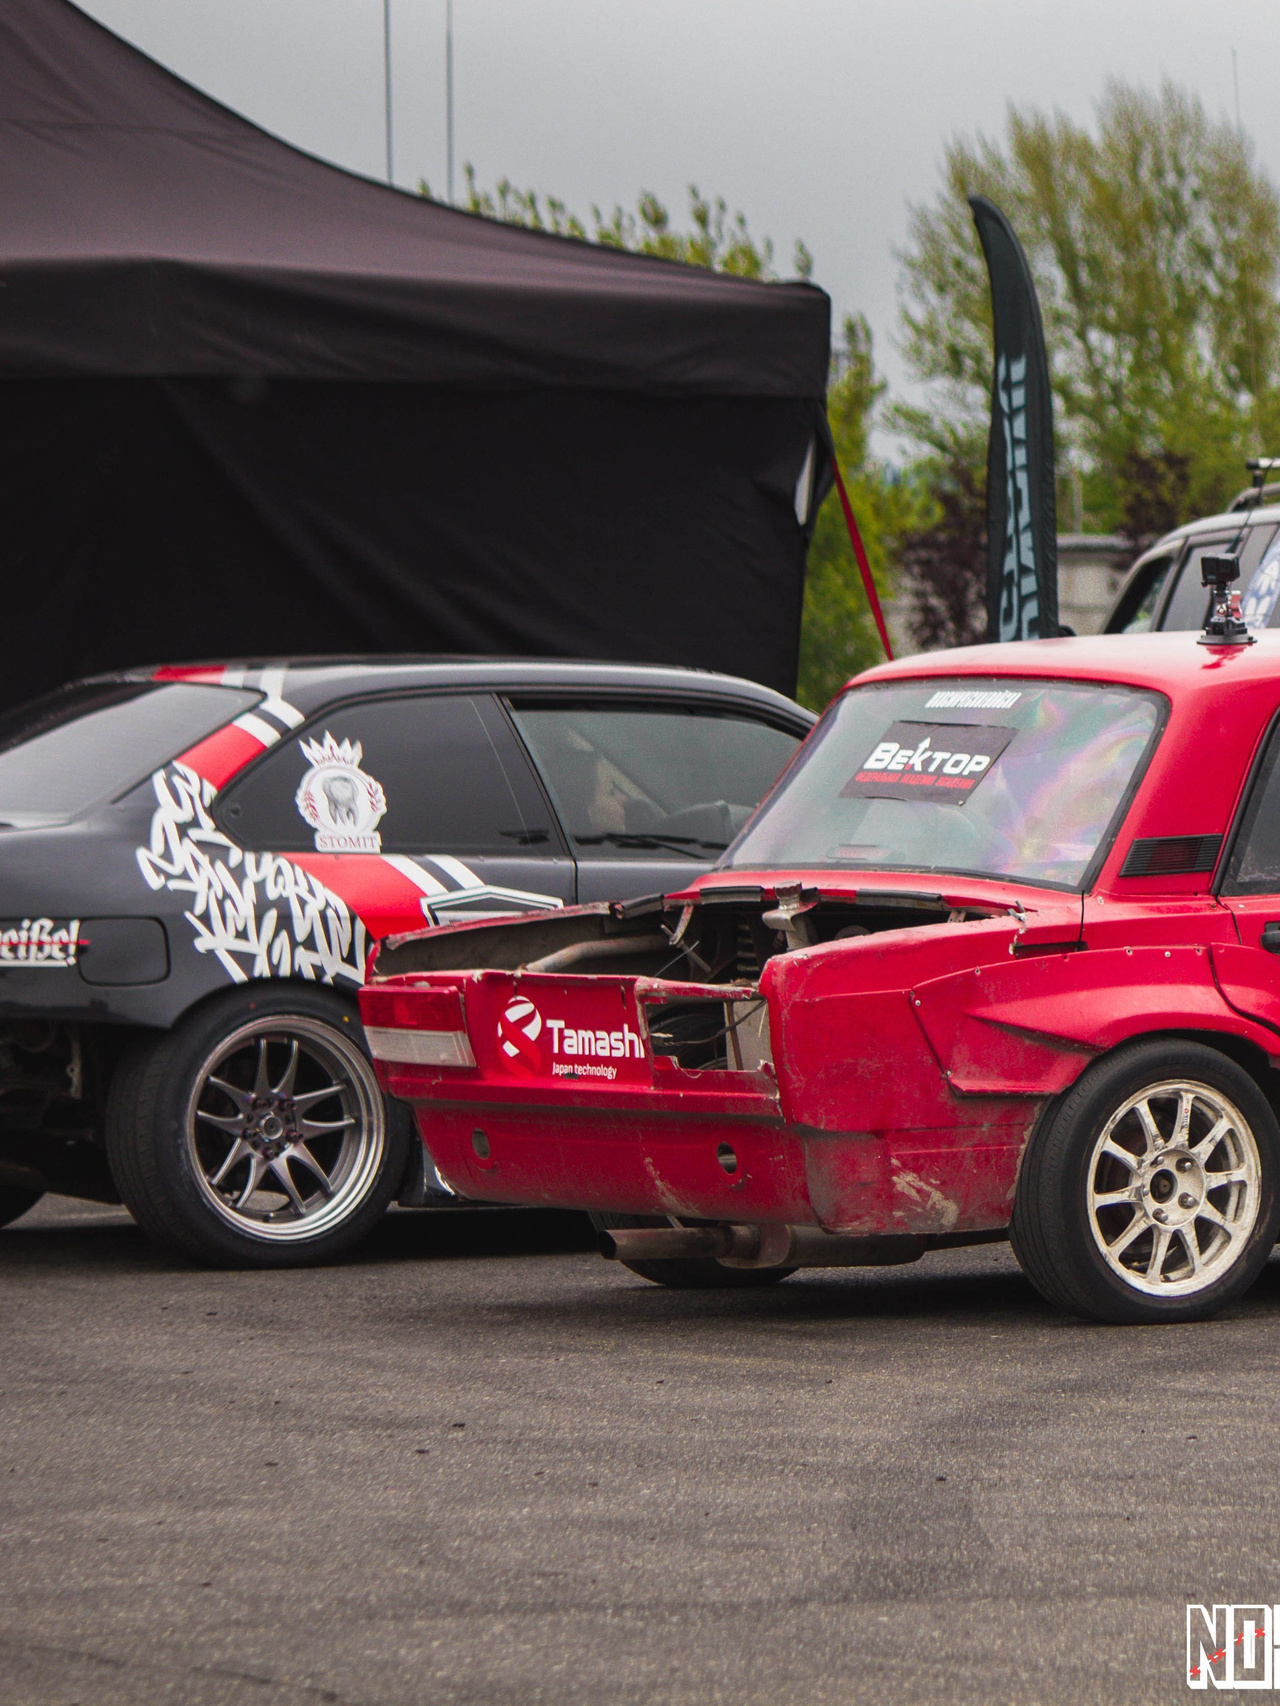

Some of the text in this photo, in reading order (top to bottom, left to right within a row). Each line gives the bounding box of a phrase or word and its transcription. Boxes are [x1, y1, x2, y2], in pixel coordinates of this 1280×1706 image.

[0, 917, 80, 966] eiße!
[552, 1061, 617, 1080] Japan technology
